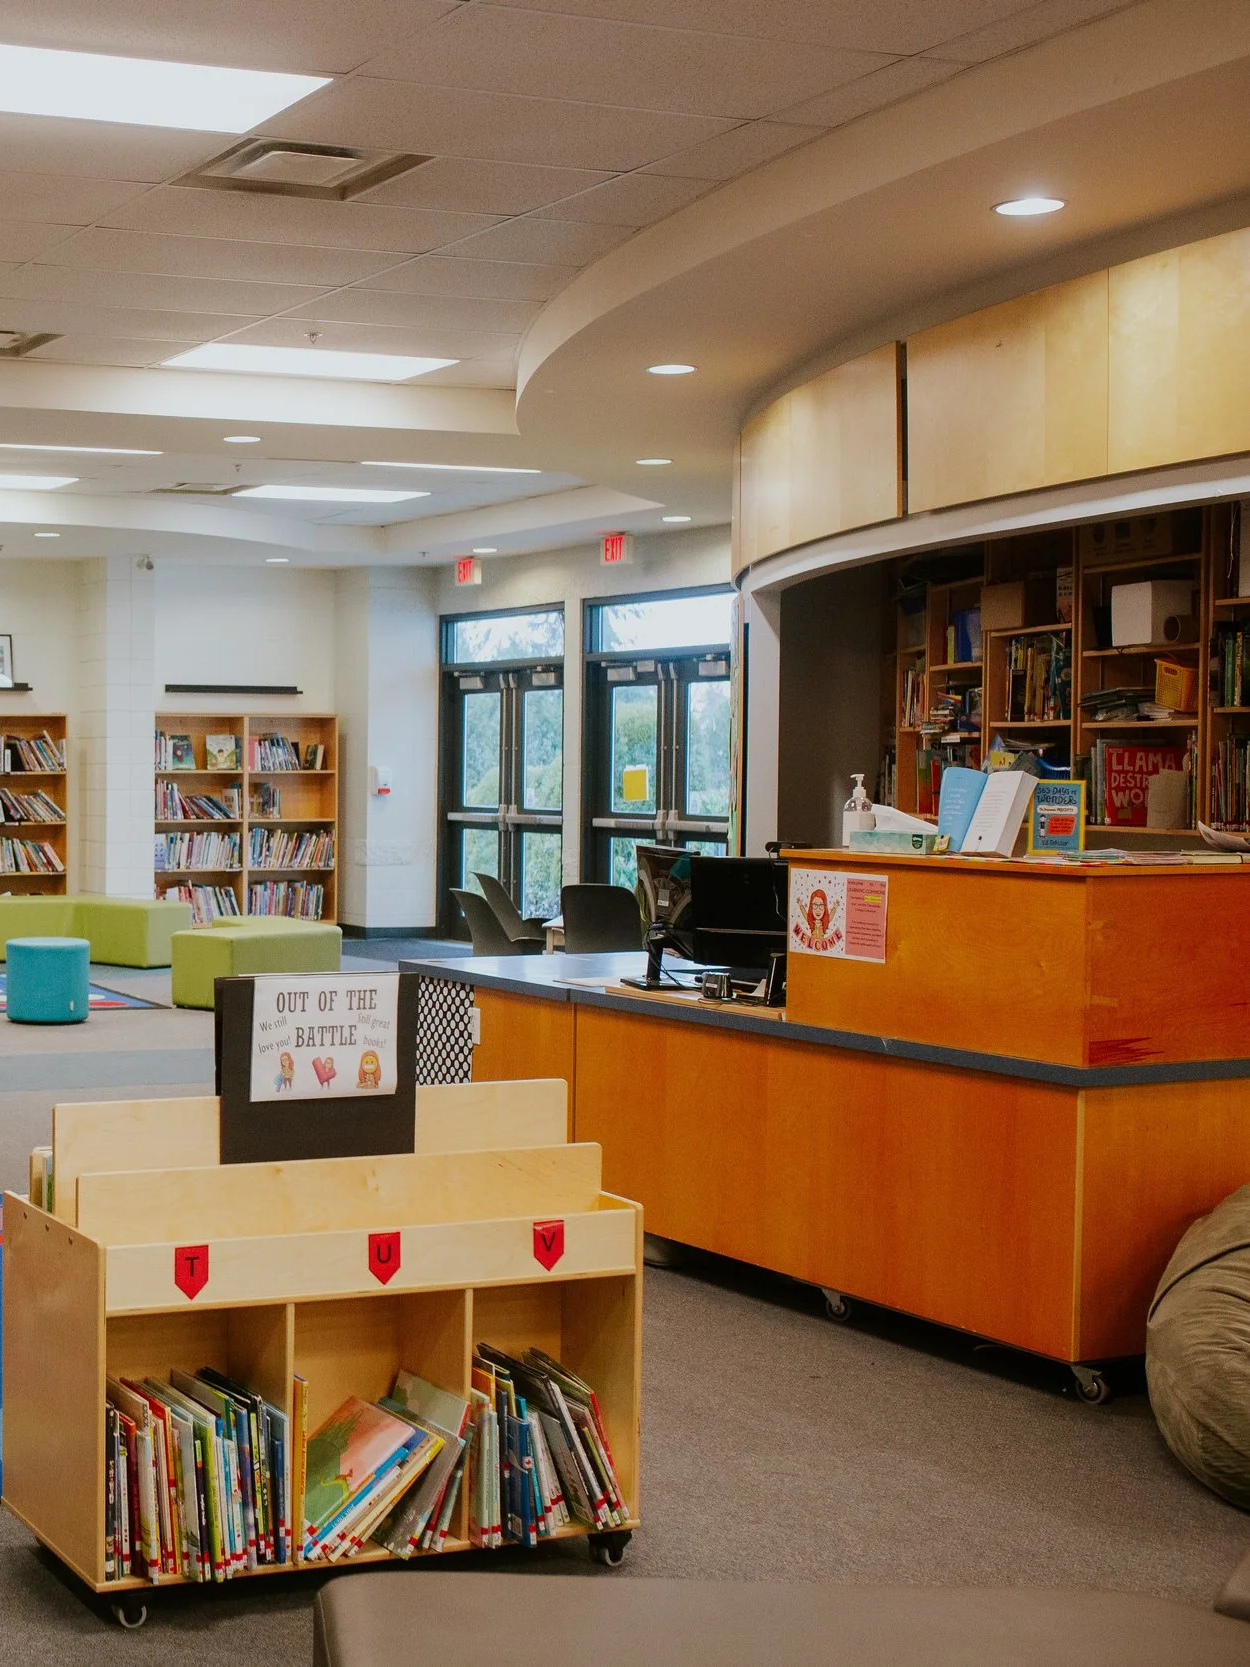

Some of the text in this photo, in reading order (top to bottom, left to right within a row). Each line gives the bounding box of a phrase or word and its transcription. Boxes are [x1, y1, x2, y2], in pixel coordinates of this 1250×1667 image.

[605, 535, 624, 562] EXIT
[458, 559, 473, 583] EXIT
[1111, 752, 1176, 772] LLAMA
[1111, 773, 1149, 788] DESTR
[793, 921, 843, 952] WELCOME
[276, 989, 378, 1014] OUT OF THE
[259, 1015, 288, 1032] We still
[370, 1018, 390, 1030] great
[258, 1036, 292, 1054] love you!
[294, 1024, 357, 1048] BATTLE
[363, 1034, 388, 1048] books!
[541, 1232, 556, 1253] V
[376, 1244, 391, 1264] U
[184, 1256, 199, 1278] T
